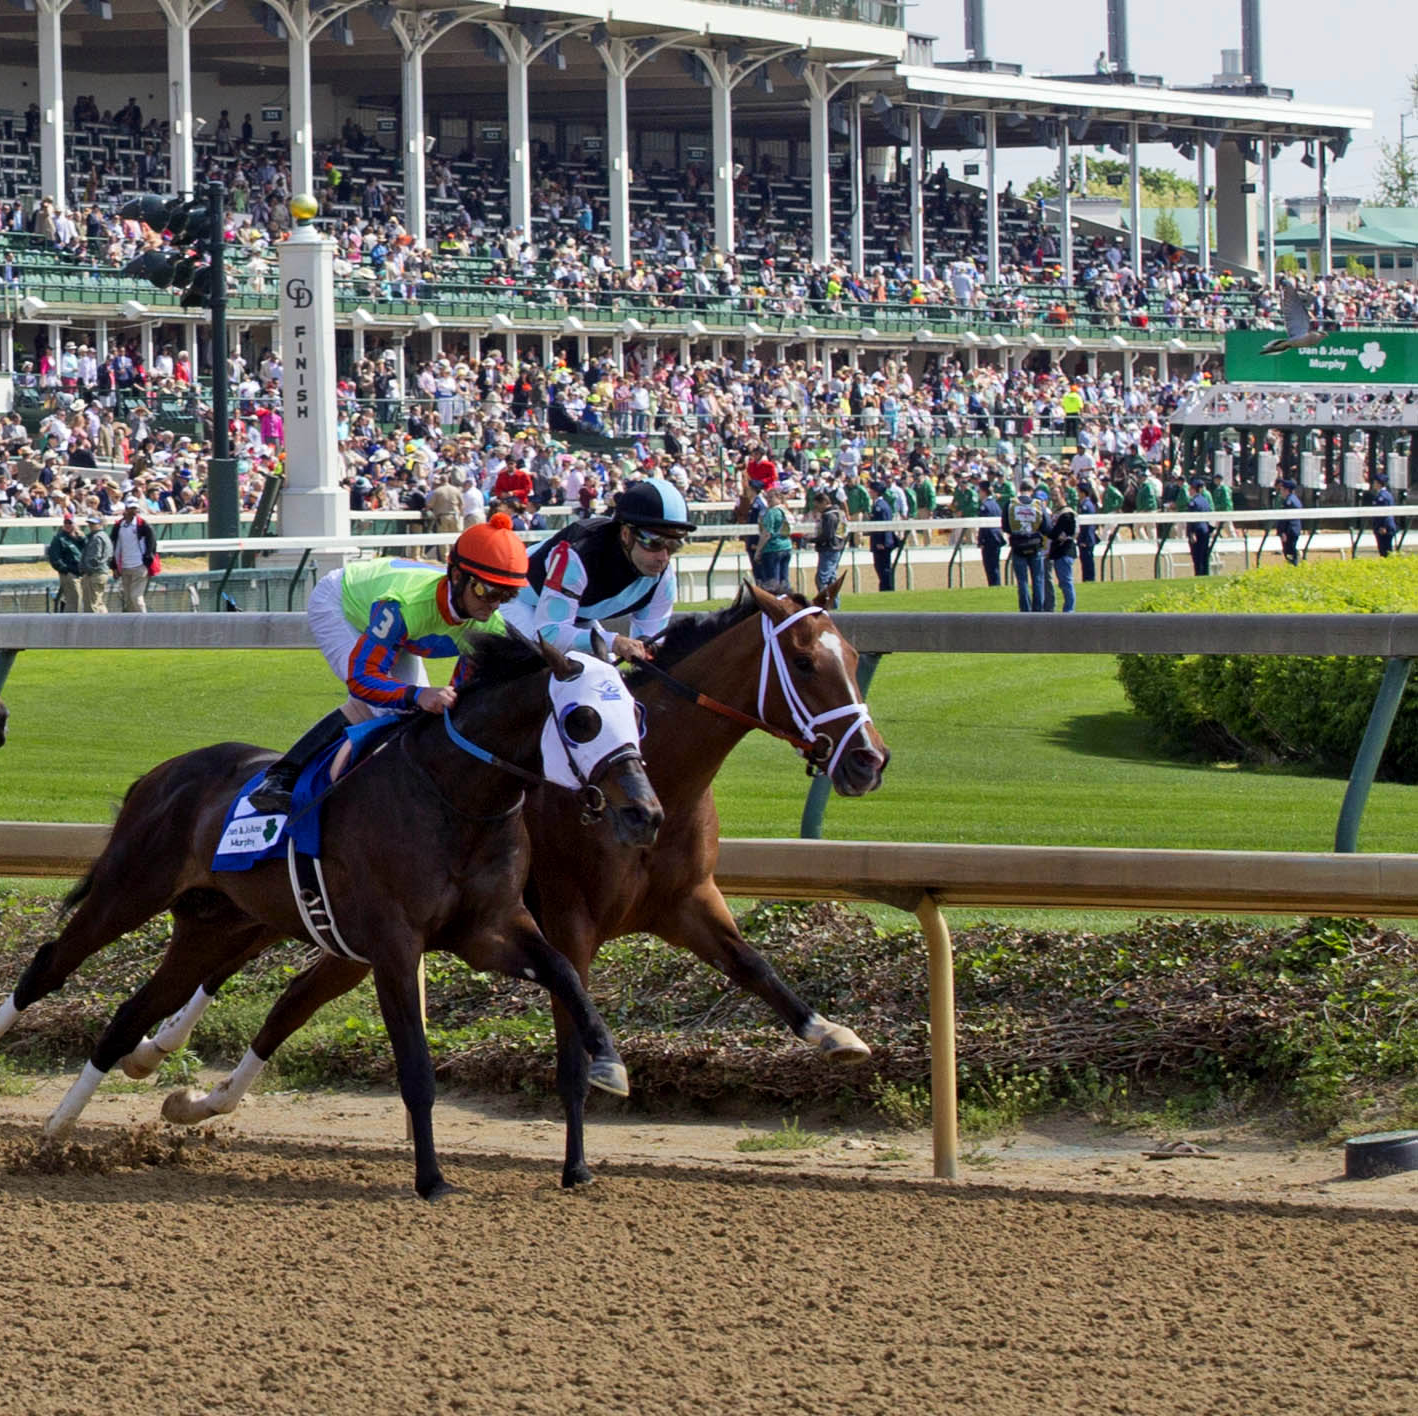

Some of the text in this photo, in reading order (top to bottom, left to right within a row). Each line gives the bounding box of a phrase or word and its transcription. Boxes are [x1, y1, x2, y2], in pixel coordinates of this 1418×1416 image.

[1298, 346, 1358, 356] Dan & JoAnn
[294, 326, 308, 418] FINISH
[1309, 358, 1347, 371] Murphy
[372, 607, 394, 639] 3
